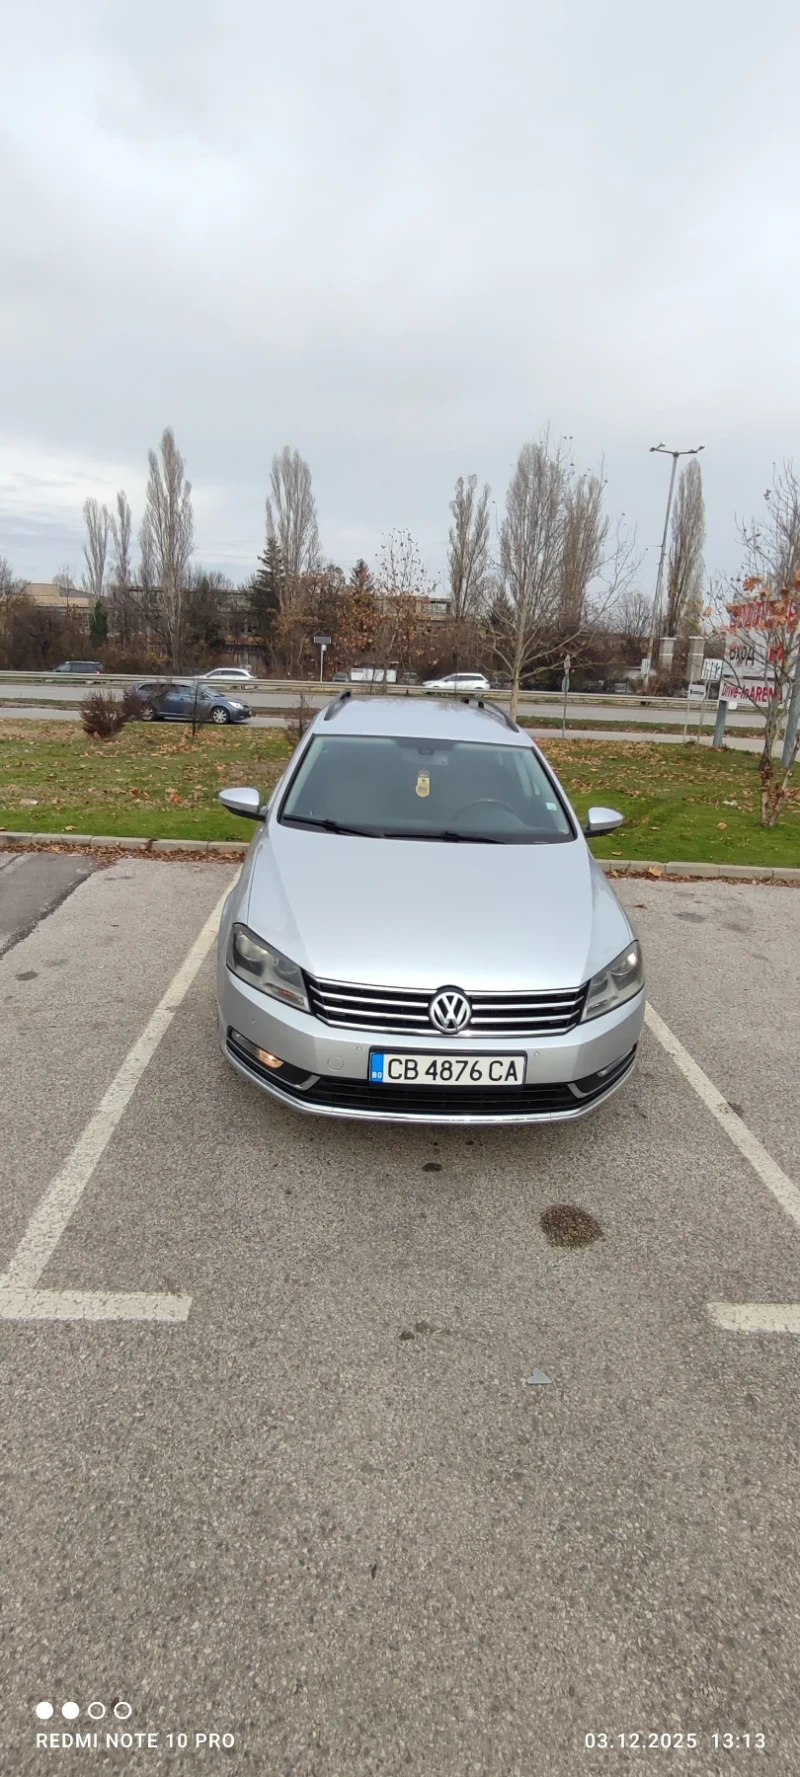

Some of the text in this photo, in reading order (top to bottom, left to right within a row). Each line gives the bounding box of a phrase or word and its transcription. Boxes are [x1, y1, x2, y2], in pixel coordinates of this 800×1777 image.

[430, 992, 471, 1033] VW
[372, 1071, 383, 1079] BG
[387, 1058, 518, 1081] CB 4876 CA
